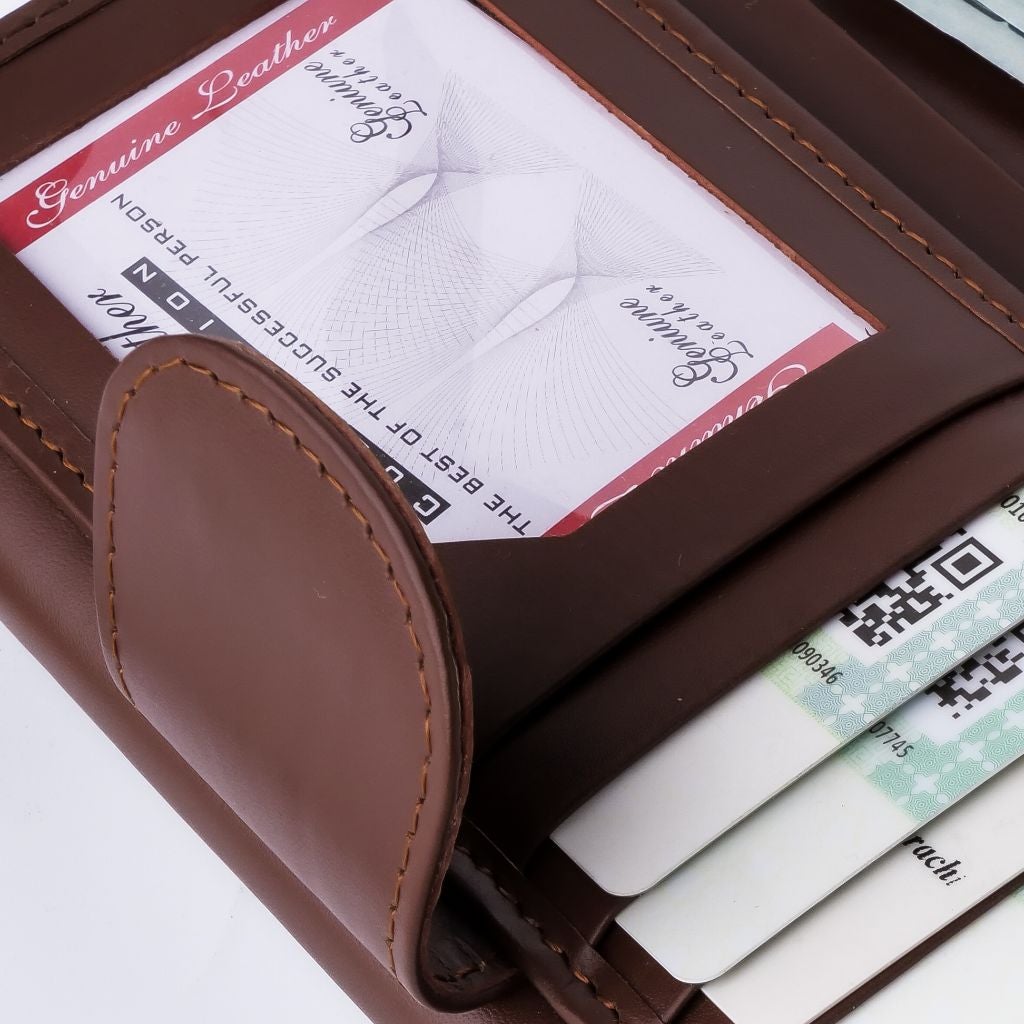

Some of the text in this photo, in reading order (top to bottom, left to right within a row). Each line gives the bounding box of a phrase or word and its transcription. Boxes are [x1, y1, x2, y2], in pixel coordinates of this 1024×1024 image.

[26, 16, 336, 229] Genuine Leather
[304, 61, 412, 143] Genuine
[110, 193, 531, 536] THE BEST OF THE SUCCESSFUL PERSON
[620, 298, 738, 388] Genuine
[792, 641, 843, 684] 090346
